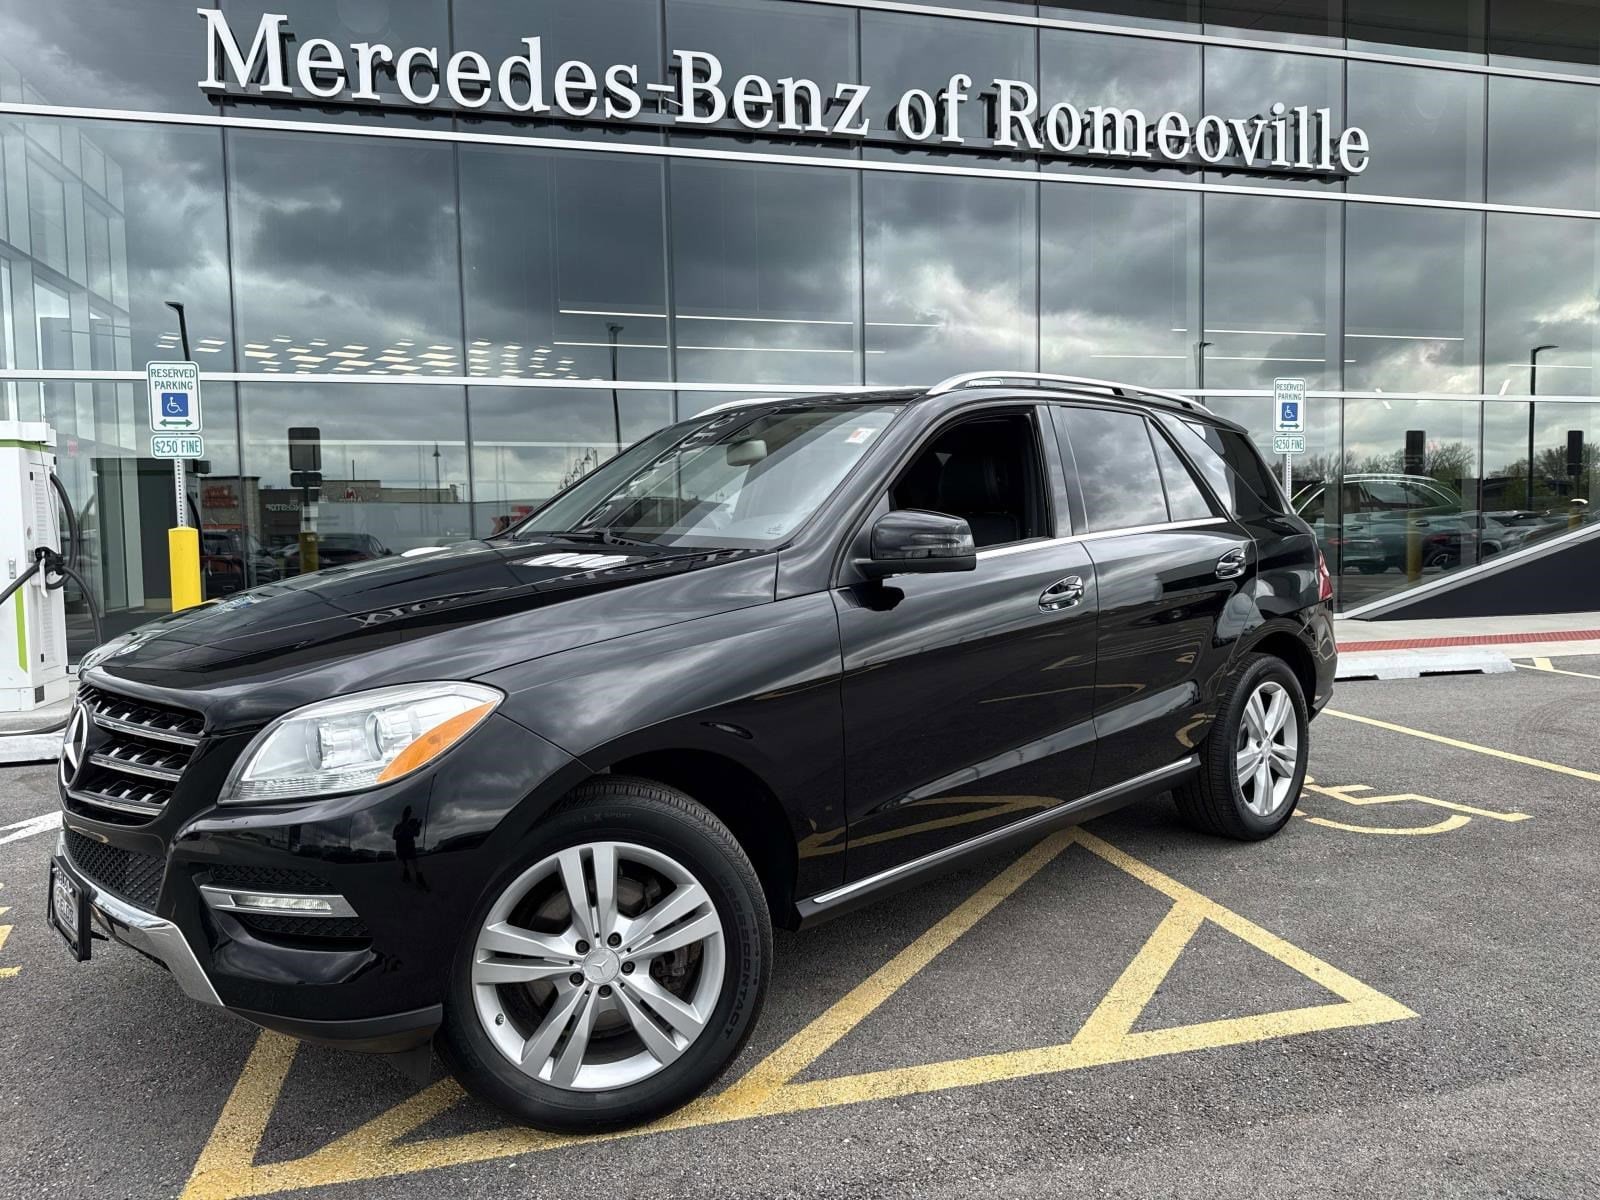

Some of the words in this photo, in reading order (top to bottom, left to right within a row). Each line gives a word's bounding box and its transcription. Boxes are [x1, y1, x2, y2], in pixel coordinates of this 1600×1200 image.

[198, 8, 871, 136] Mercedes-Benz
[898, 74, 972, 145] of
[993, 79, 1370, 173] Romeoville
[150, 368, 195, 378] RESERVED
[154, 381, 193, 390] PARKING
[155, 440, 178, 453] $250
[181, 440, 200, 453] FINE
[1275, 439, 1290, 449] $250
[1291, 439, 1303, 449] FINE
